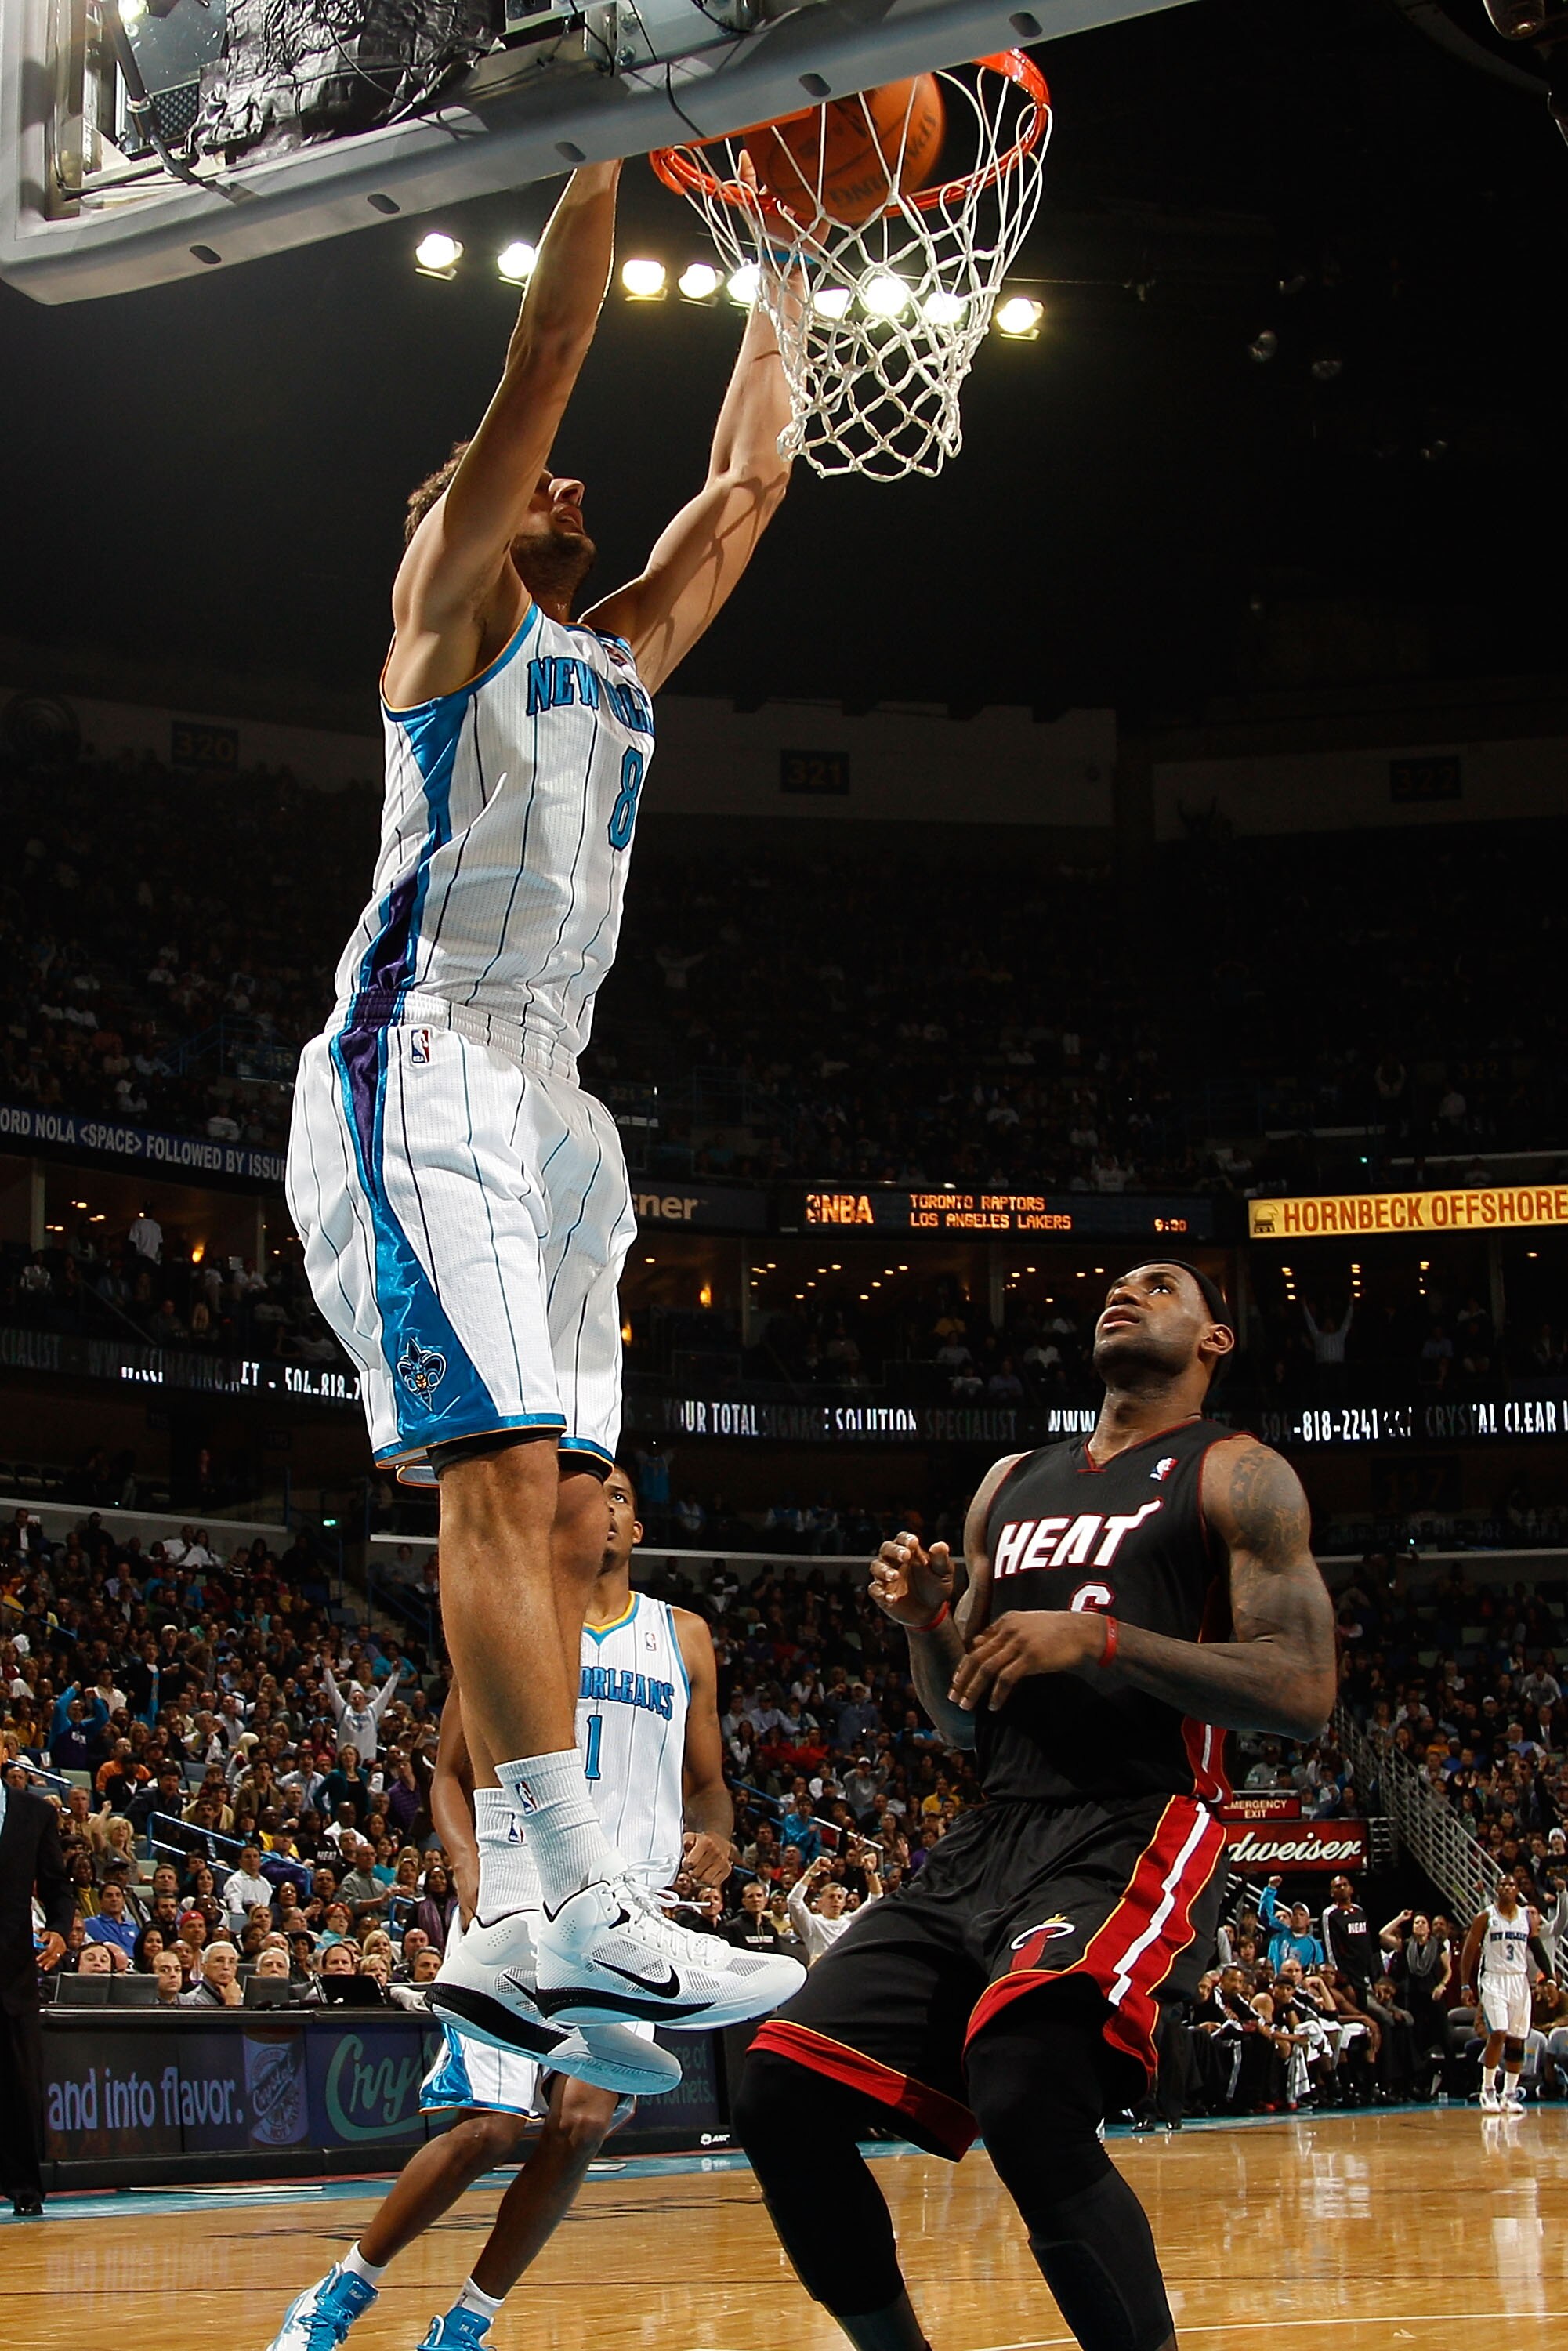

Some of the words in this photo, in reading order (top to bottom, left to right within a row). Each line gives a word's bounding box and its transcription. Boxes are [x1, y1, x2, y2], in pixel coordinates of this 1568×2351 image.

[526, 656, 599, 716] NEW
[608, 745, 643, 852] 8
[36, 1115, 75, 1143] NOLA
[79, 1122, 143, 1155] <SPACE>
[146, 1135, 222, 1172] FOLLOWED
[225, 1149, 244, 1175] BY
[821, 1194, 875, 1225] NBA
[910, 1194, 973, 1210] TORONTO
[981, 1195, 1045, 1212] RAPTORS
[910, 1212, 938, 1227] LOS
[945, 1213, 1009, 1229] ANGELES
[1017, 1215, 1072, 1230] LAKERS
[1284, 1196, 1424, 1232] HORNBECK
[1431, 1189, 1568, 1227] OFFSHORE
[712, 1401, 759, 1436] TOTAL
[1505, 1400, 1557, 1434] CLEAR
[994, 1497, 1164, 1580] HEAT
[585, 1715, 603, 1780] 1
[1244, 1809, 1266, 1819] EXIT
[1506, 1943, 1515, 1961] 3
[48, 2068, 97, 2132] and
[105, 2067, 155, 2131] into
[161, 2066, 244, 2127] flavor.
